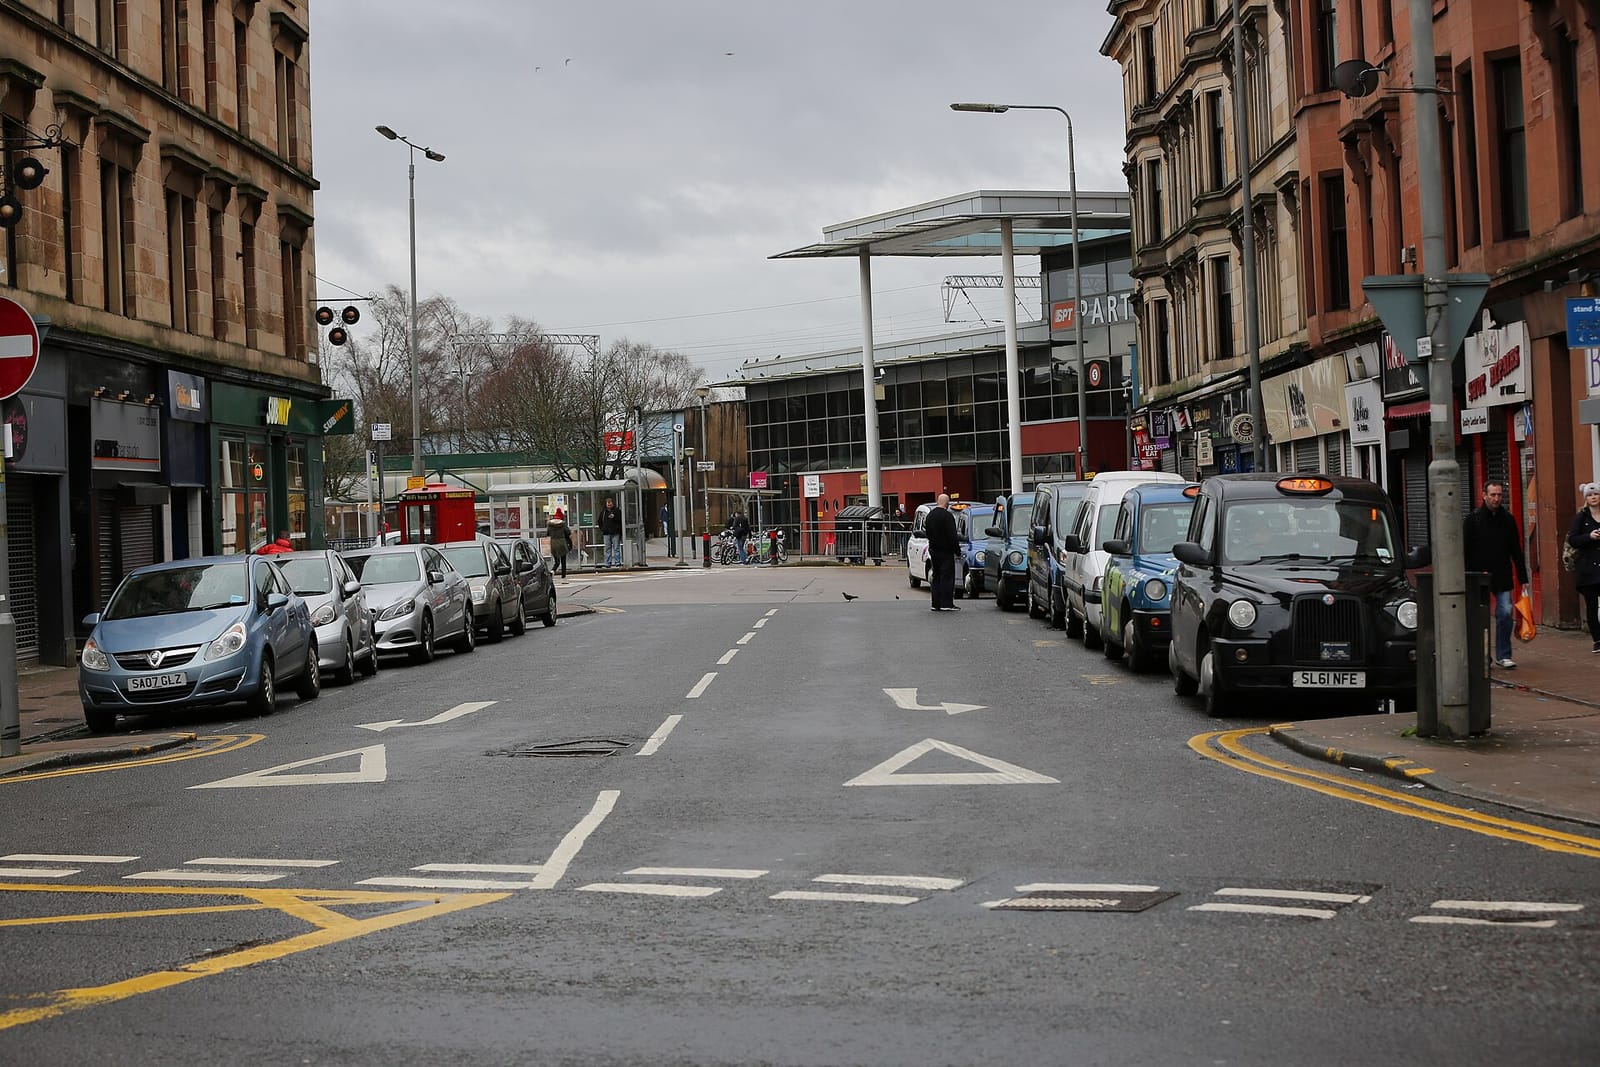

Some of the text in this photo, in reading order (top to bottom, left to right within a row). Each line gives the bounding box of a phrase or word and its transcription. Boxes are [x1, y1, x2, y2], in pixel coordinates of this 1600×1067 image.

[1573, 305, 1593, 313] stand
[1489, 345, 1520, 388] REPAIRS
[322, 401, 349, 434] SUBWAY
[1141, 444, 1157, 452] JUST
[1291, 480, 1322, 489] TAXI
[132, 674, 182, 689] SA07 GLZ
[1301, 672, 1358, 685] SL61 NFE
